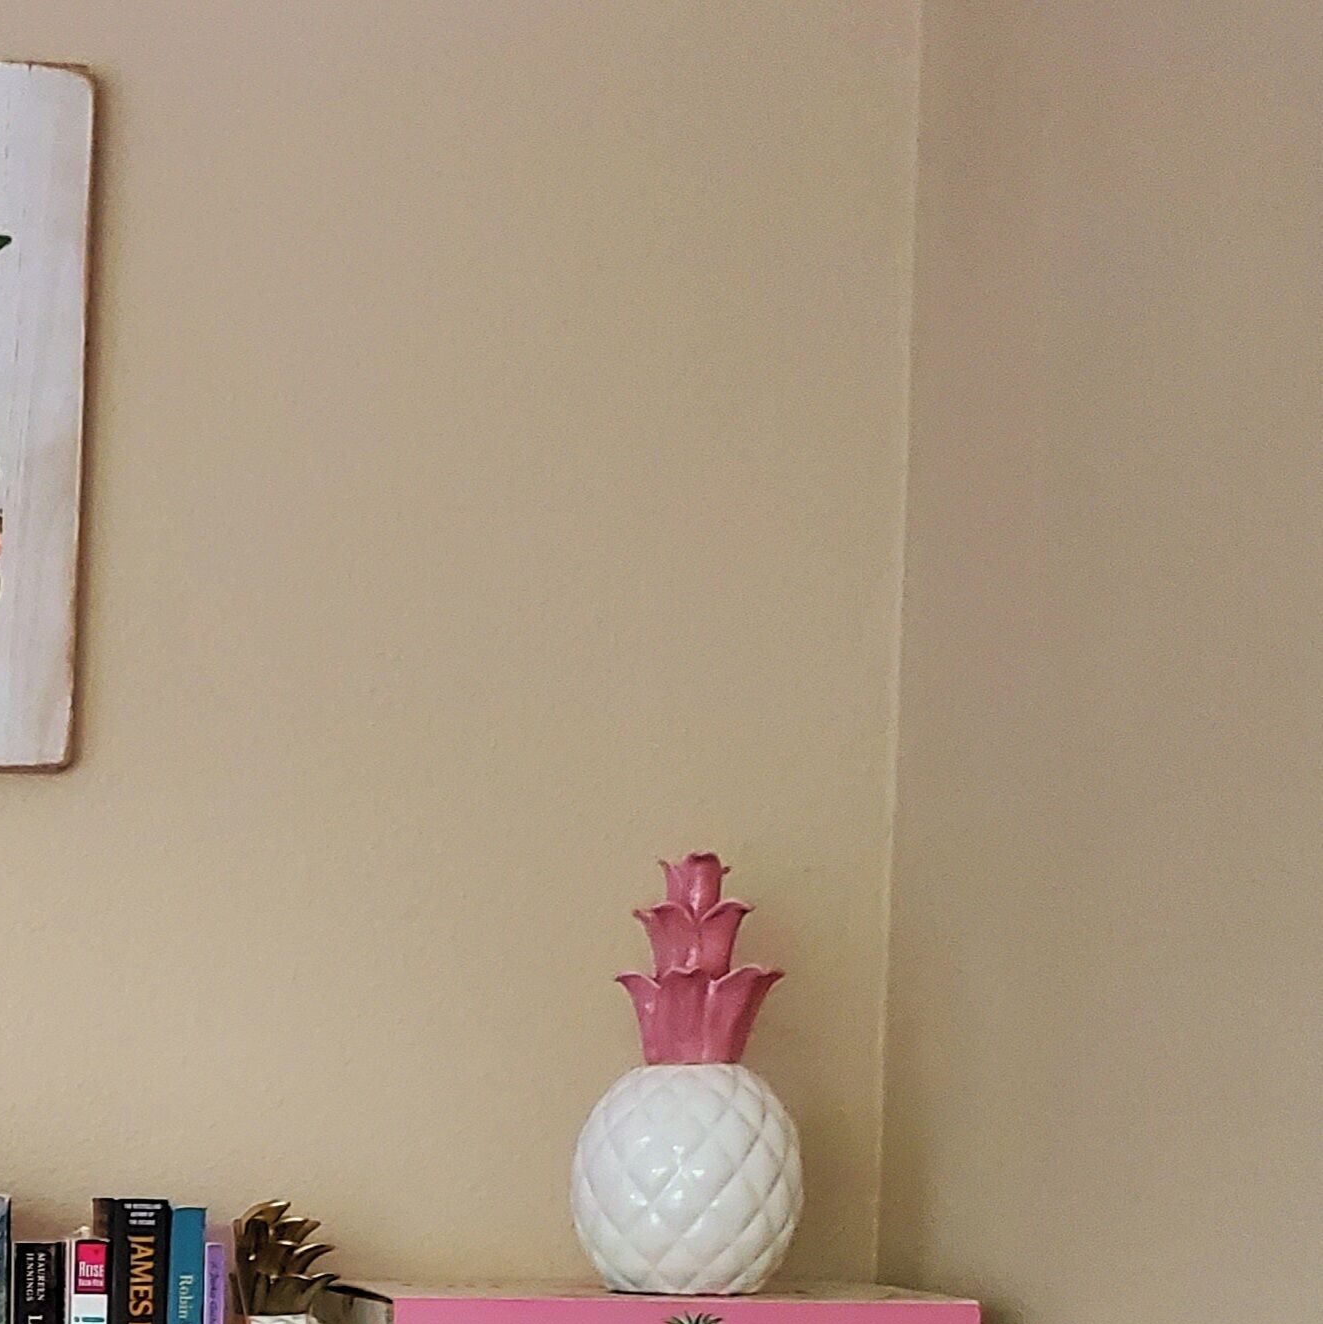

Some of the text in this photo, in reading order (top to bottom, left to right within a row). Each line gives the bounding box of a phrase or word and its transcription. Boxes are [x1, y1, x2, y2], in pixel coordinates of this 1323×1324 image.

[25, 1252, 34, 1302] JENNINGS
[37, 1252, 46, 1302] MAUREEN
[126, 1235, 155, 1316] JAMES
[178, 1274, 194, 1319] Robin
